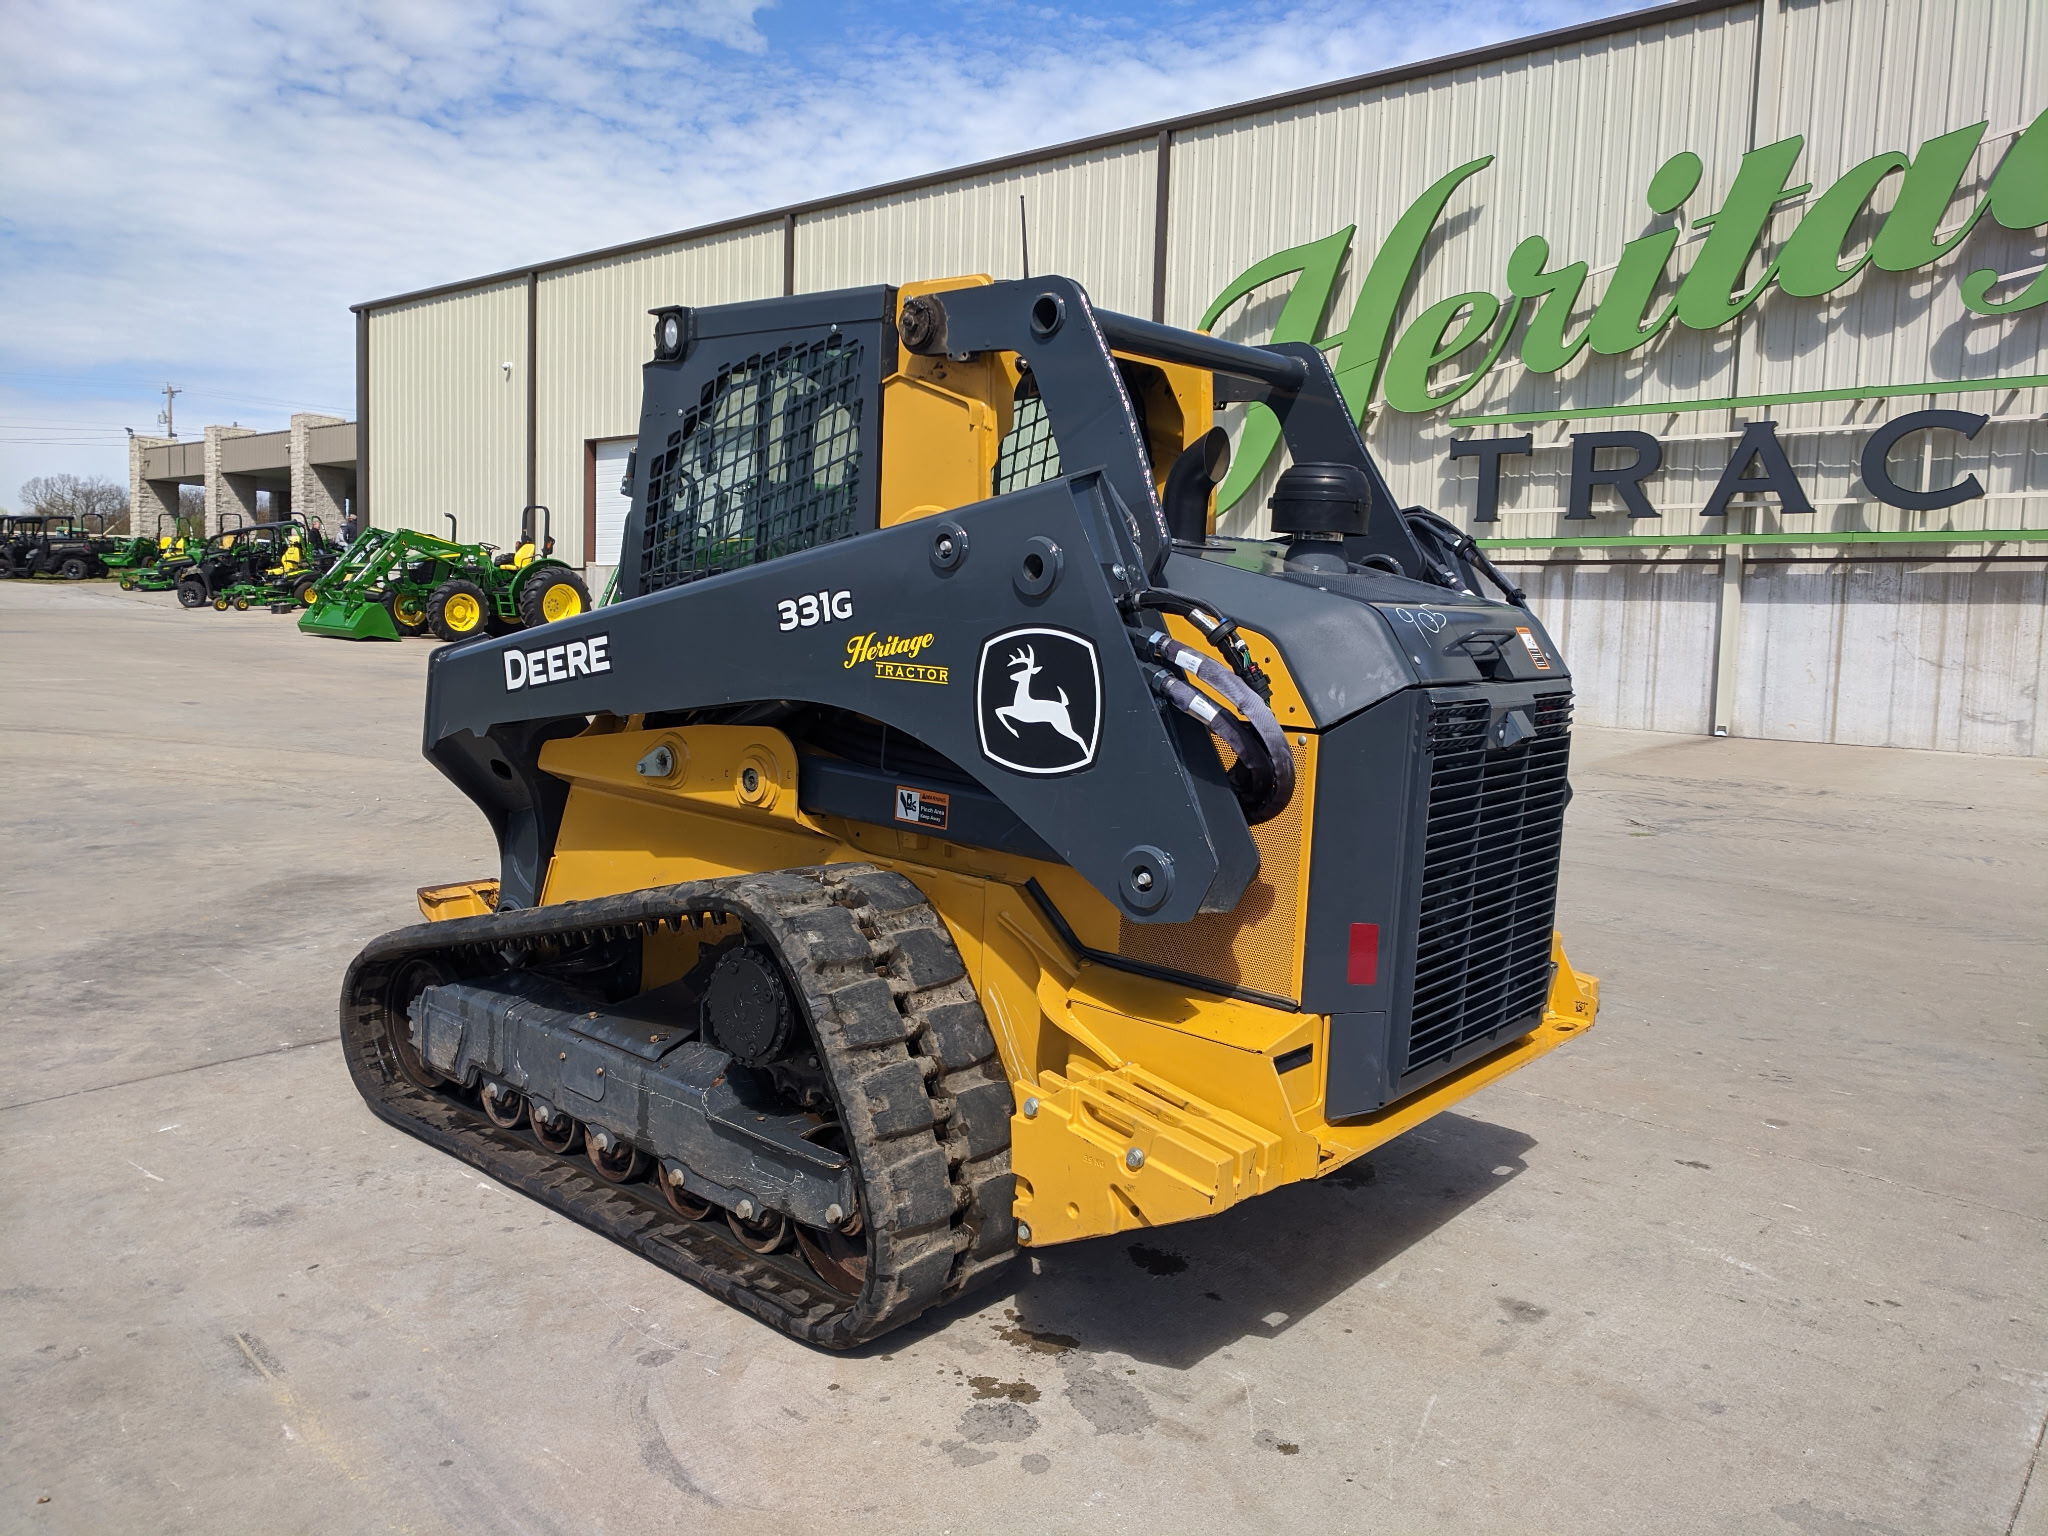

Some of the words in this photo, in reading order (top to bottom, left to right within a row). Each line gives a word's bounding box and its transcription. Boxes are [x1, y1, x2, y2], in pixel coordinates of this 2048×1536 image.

[1450, 409, 1988, 523] TRAC
[778, 590, 853, 631] 331G
[503, 635, 611, 690] DEERE
[843, 631, 935, 669] Heritage
[876, 664, 948, 681] TRACTOR
[920, 805, 933, 813] Pinch
